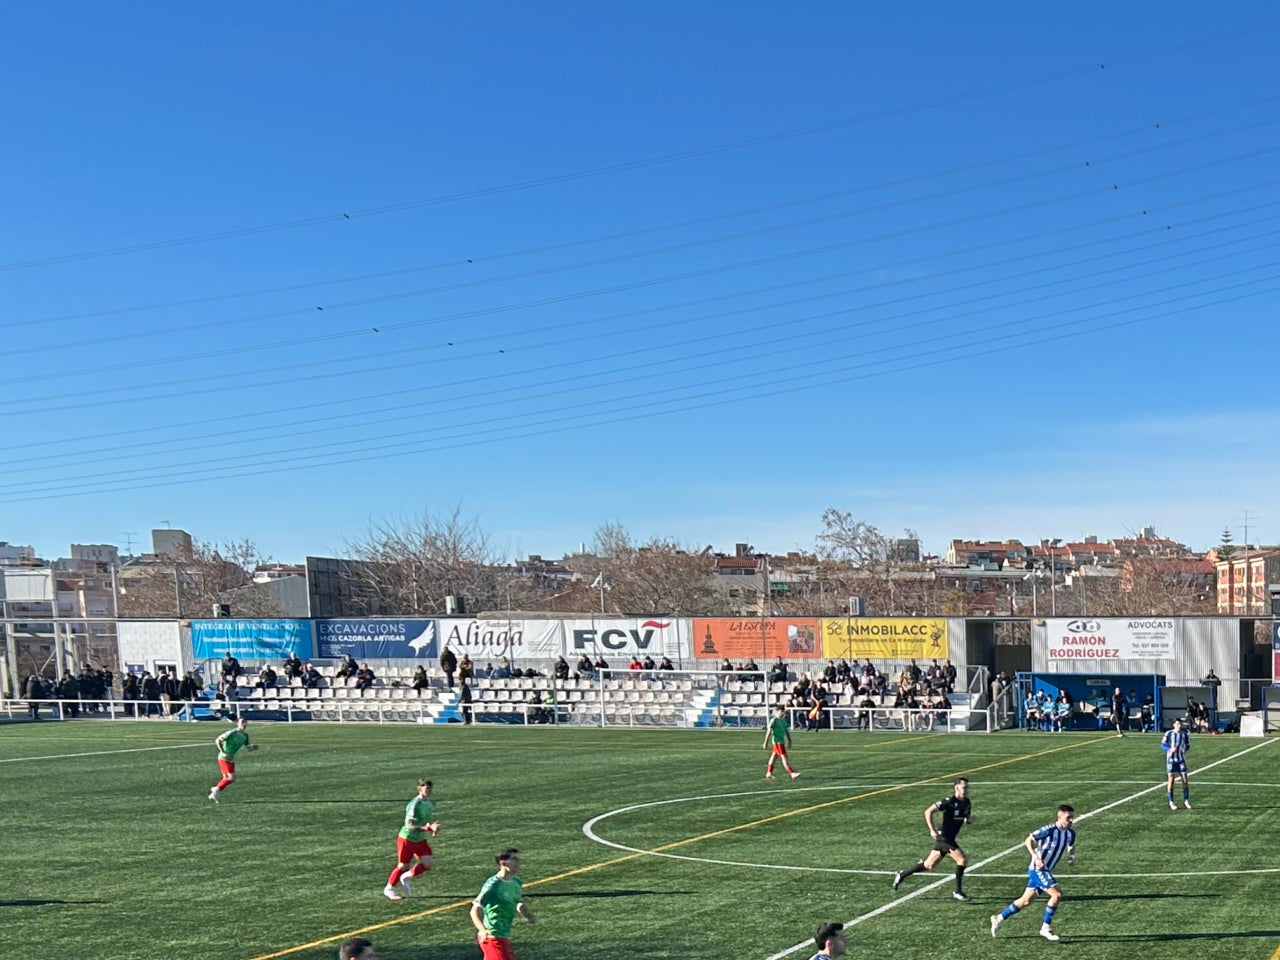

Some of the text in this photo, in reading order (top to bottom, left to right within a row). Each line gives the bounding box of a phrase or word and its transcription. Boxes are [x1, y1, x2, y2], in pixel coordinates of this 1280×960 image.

[320, 623, 406, 634] EXCAVACIONS
[847, 625, 928, 635] INMOBILACC
[1128, 621, 1173, 629] ADVOCATS
[338, 634, 372, 642] CAZORLA
[373, 634, 406, 642] ARTIGAS
[445, 620, 523, 657] Aliaga
[573, 629, 655, 649] FCV
[1062, 635, 1106, 646] RAMÓN
[1050, 646, 1120, 658] RODRÍGUEZ
